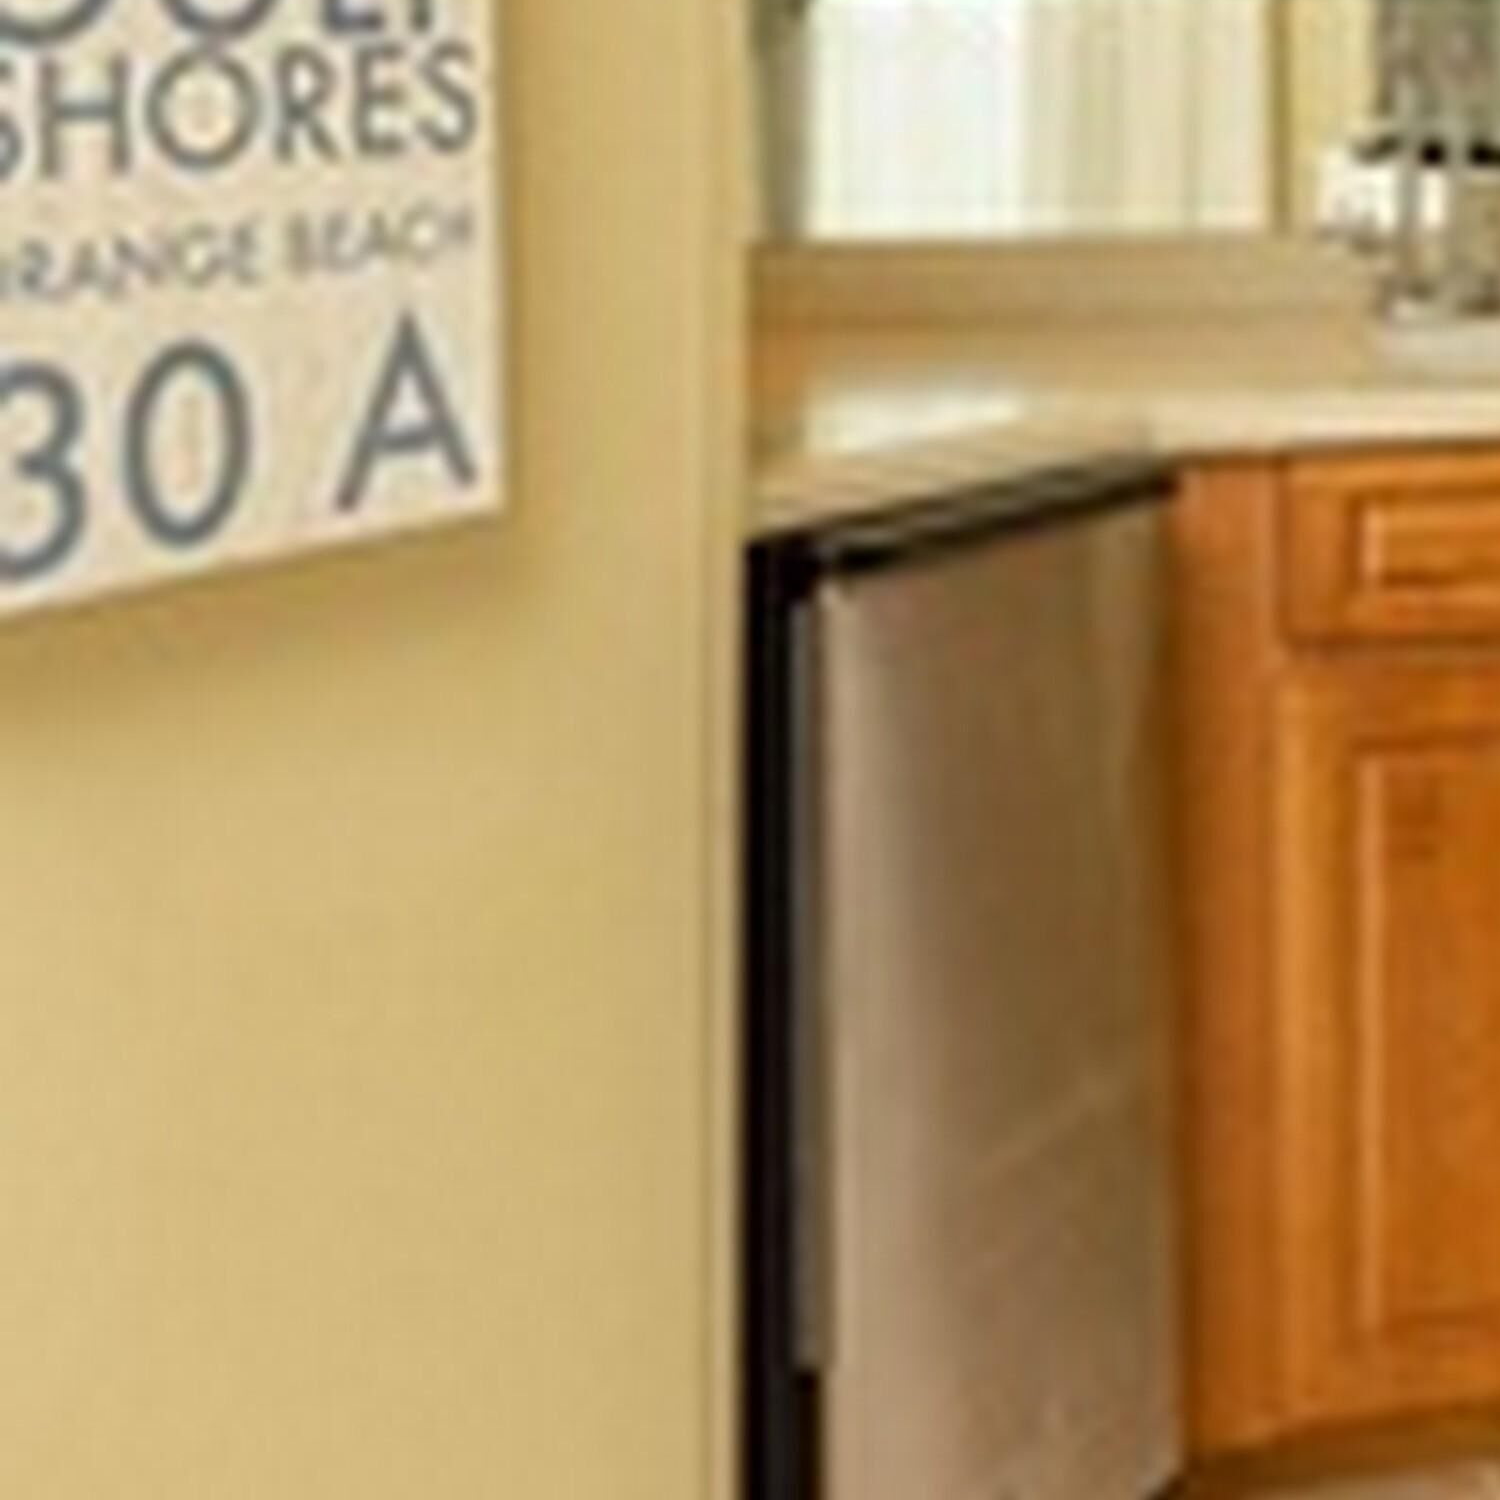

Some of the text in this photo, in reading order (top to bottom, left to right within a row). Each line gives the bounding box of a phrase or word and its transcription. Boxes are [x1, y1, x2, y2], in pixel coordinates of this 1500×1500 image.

[0, 202, 475, 302] RANGE BEACH
[0, 312, 478, 581] 30 A
